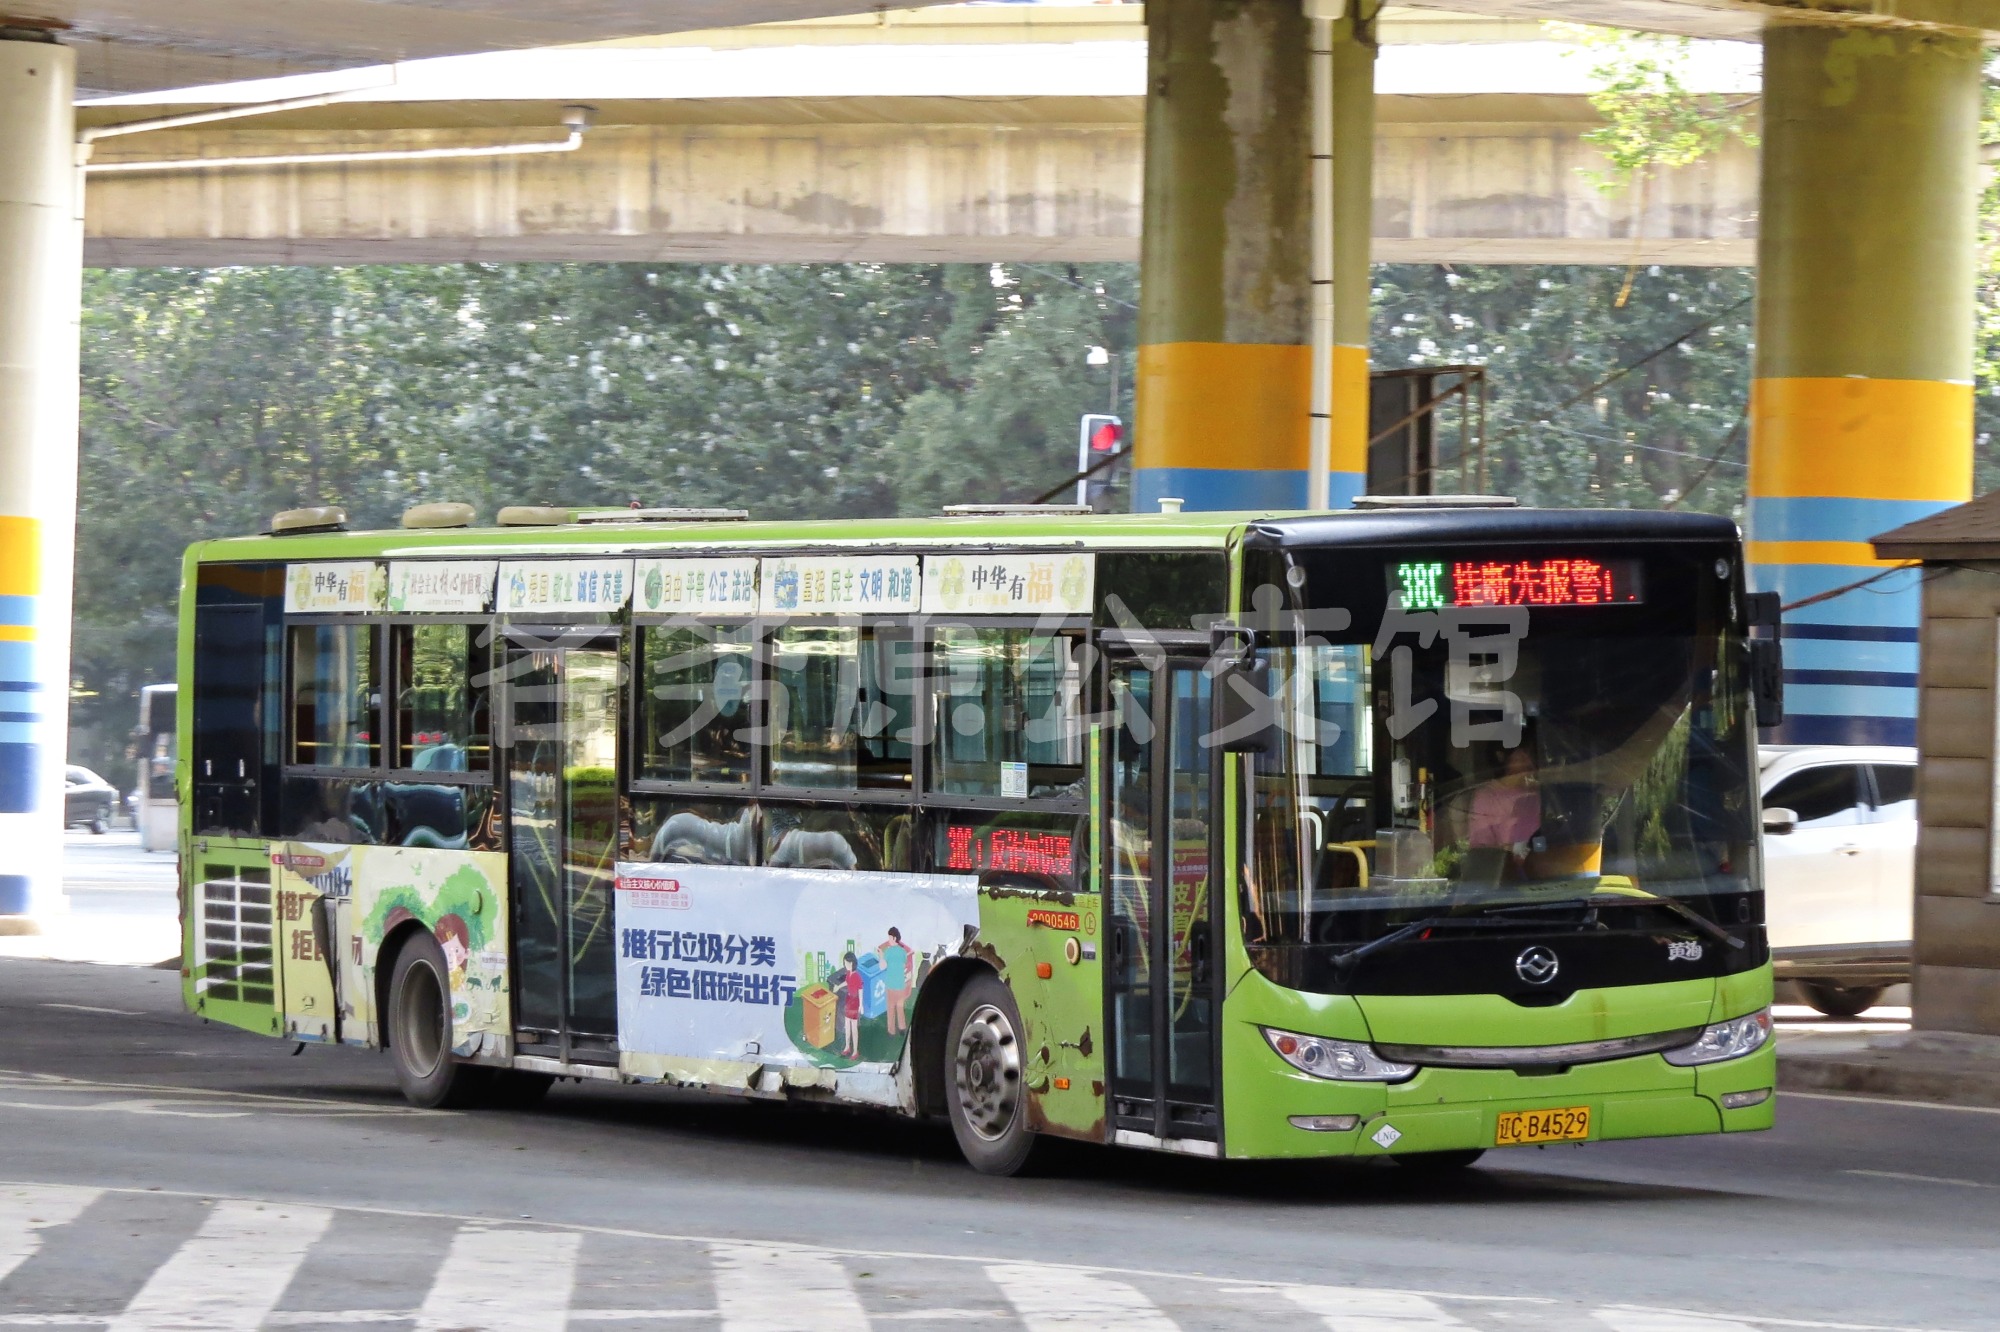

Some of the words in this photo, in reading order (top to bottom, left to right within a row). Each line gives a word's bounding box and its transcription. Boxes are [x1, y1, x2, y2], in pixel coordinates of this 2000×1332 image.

[972, 562, 1054, 604] 中华有福
[622, 928, 776, 967] 推行垃圾分类
[640, 966, 797, 1007] 绿色低碳出行
[1376, 1130, 1397, 1143] LNG
